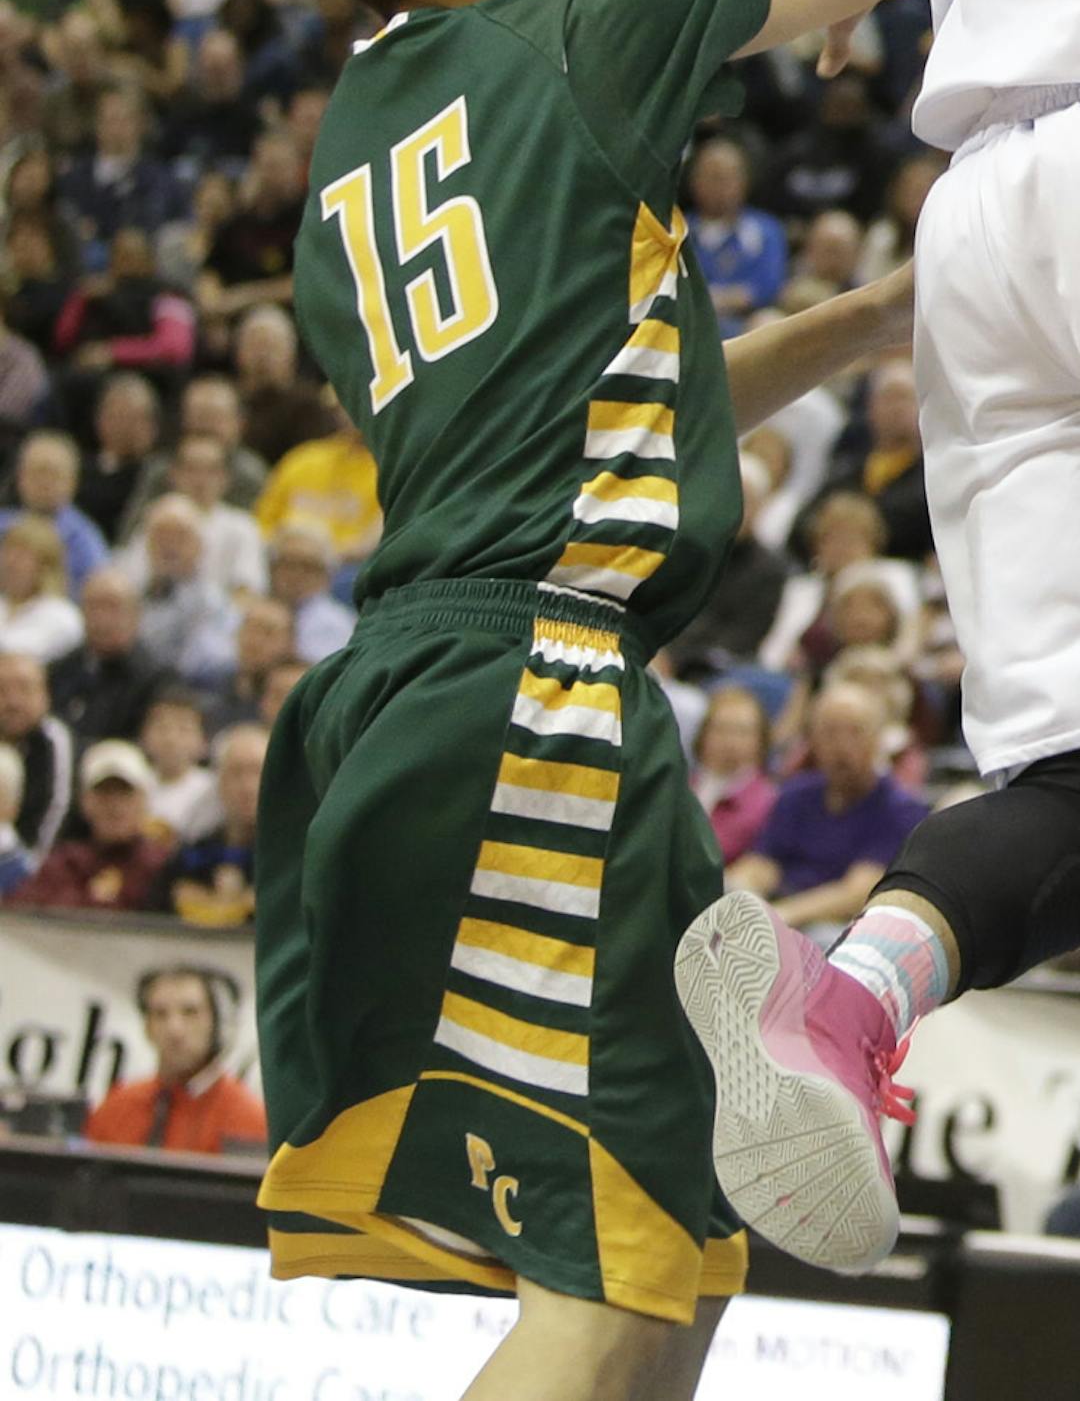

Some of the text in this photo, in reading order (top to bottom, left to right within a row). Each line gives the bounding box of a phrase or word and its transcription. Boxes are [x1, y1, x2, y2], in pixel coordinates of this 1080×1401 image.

[319, 94, 499, 417] 15
[20, 1243, 292, 1326] Orthopedic
[320, 1279, 436, 1336] Care
